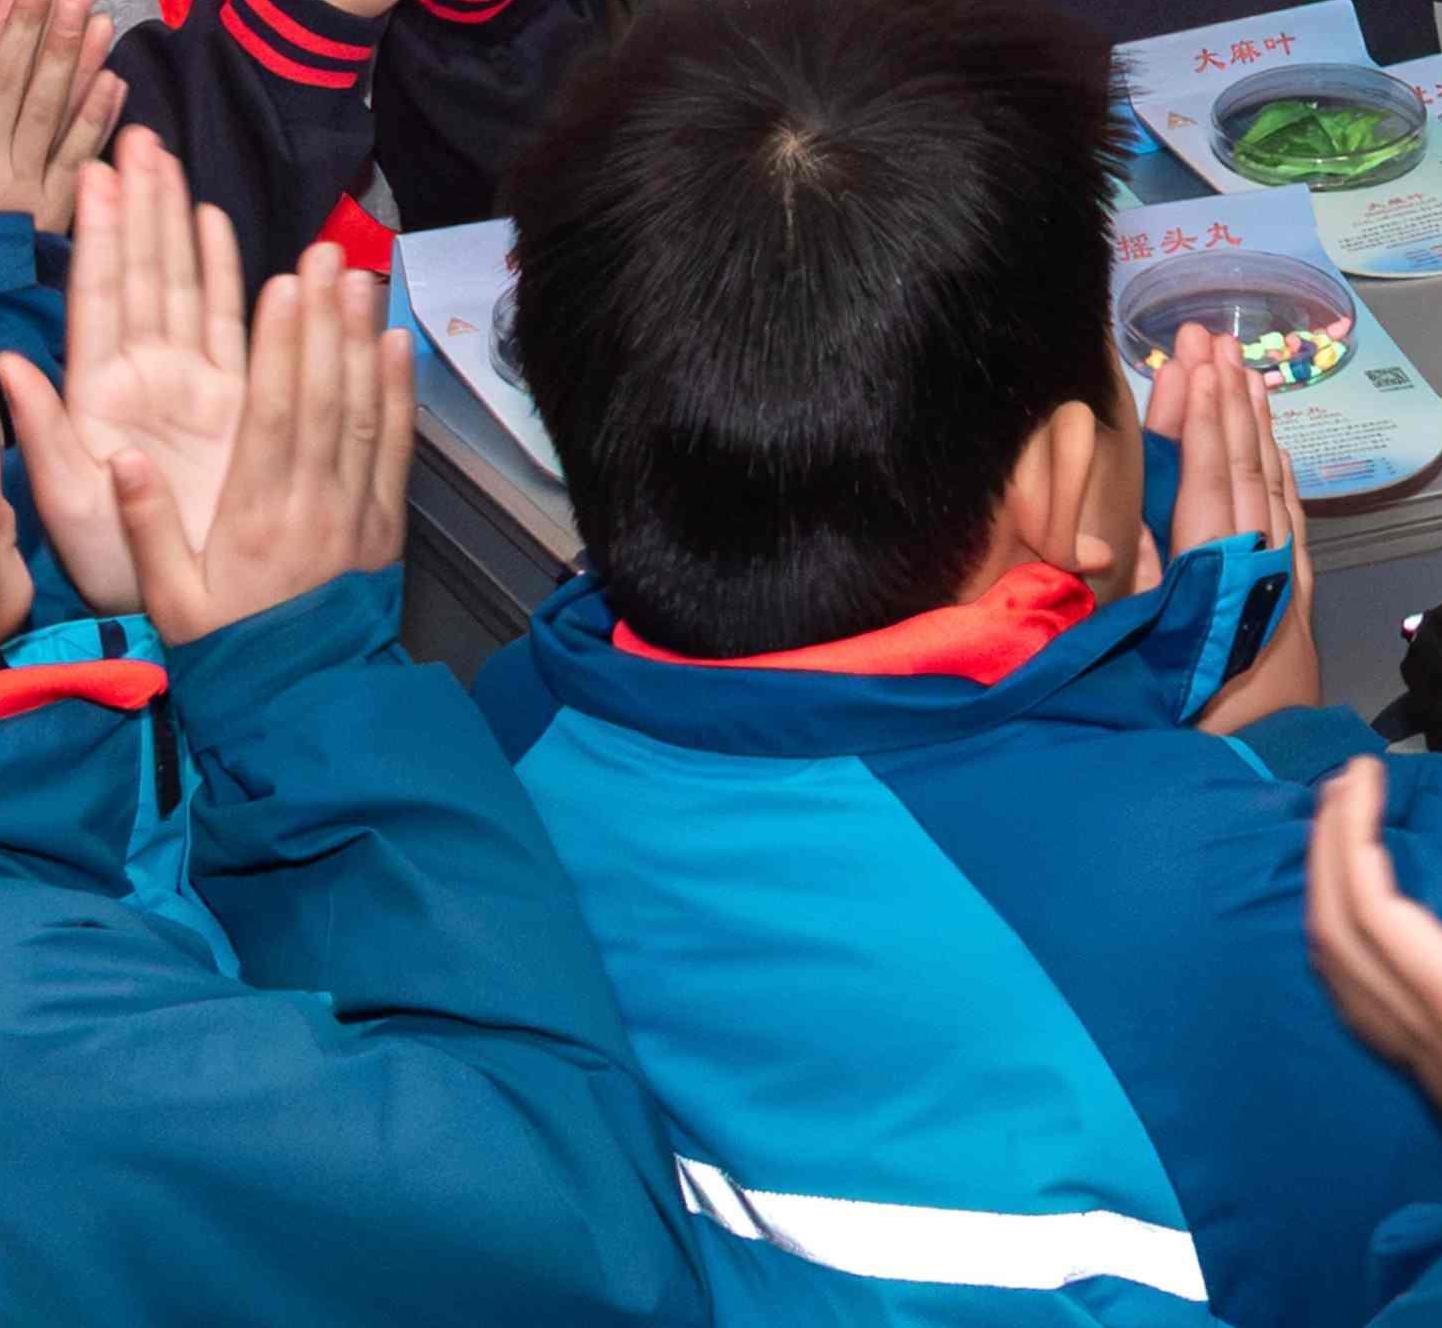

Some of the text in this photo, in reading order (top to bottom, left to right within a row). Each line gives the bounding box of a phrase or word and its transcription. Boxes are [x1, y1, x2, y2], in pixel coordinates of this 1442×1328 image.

[1193, 32, 1298, 75] 大麻叶
[1116, 222, 1244, 263] 摇头丸
